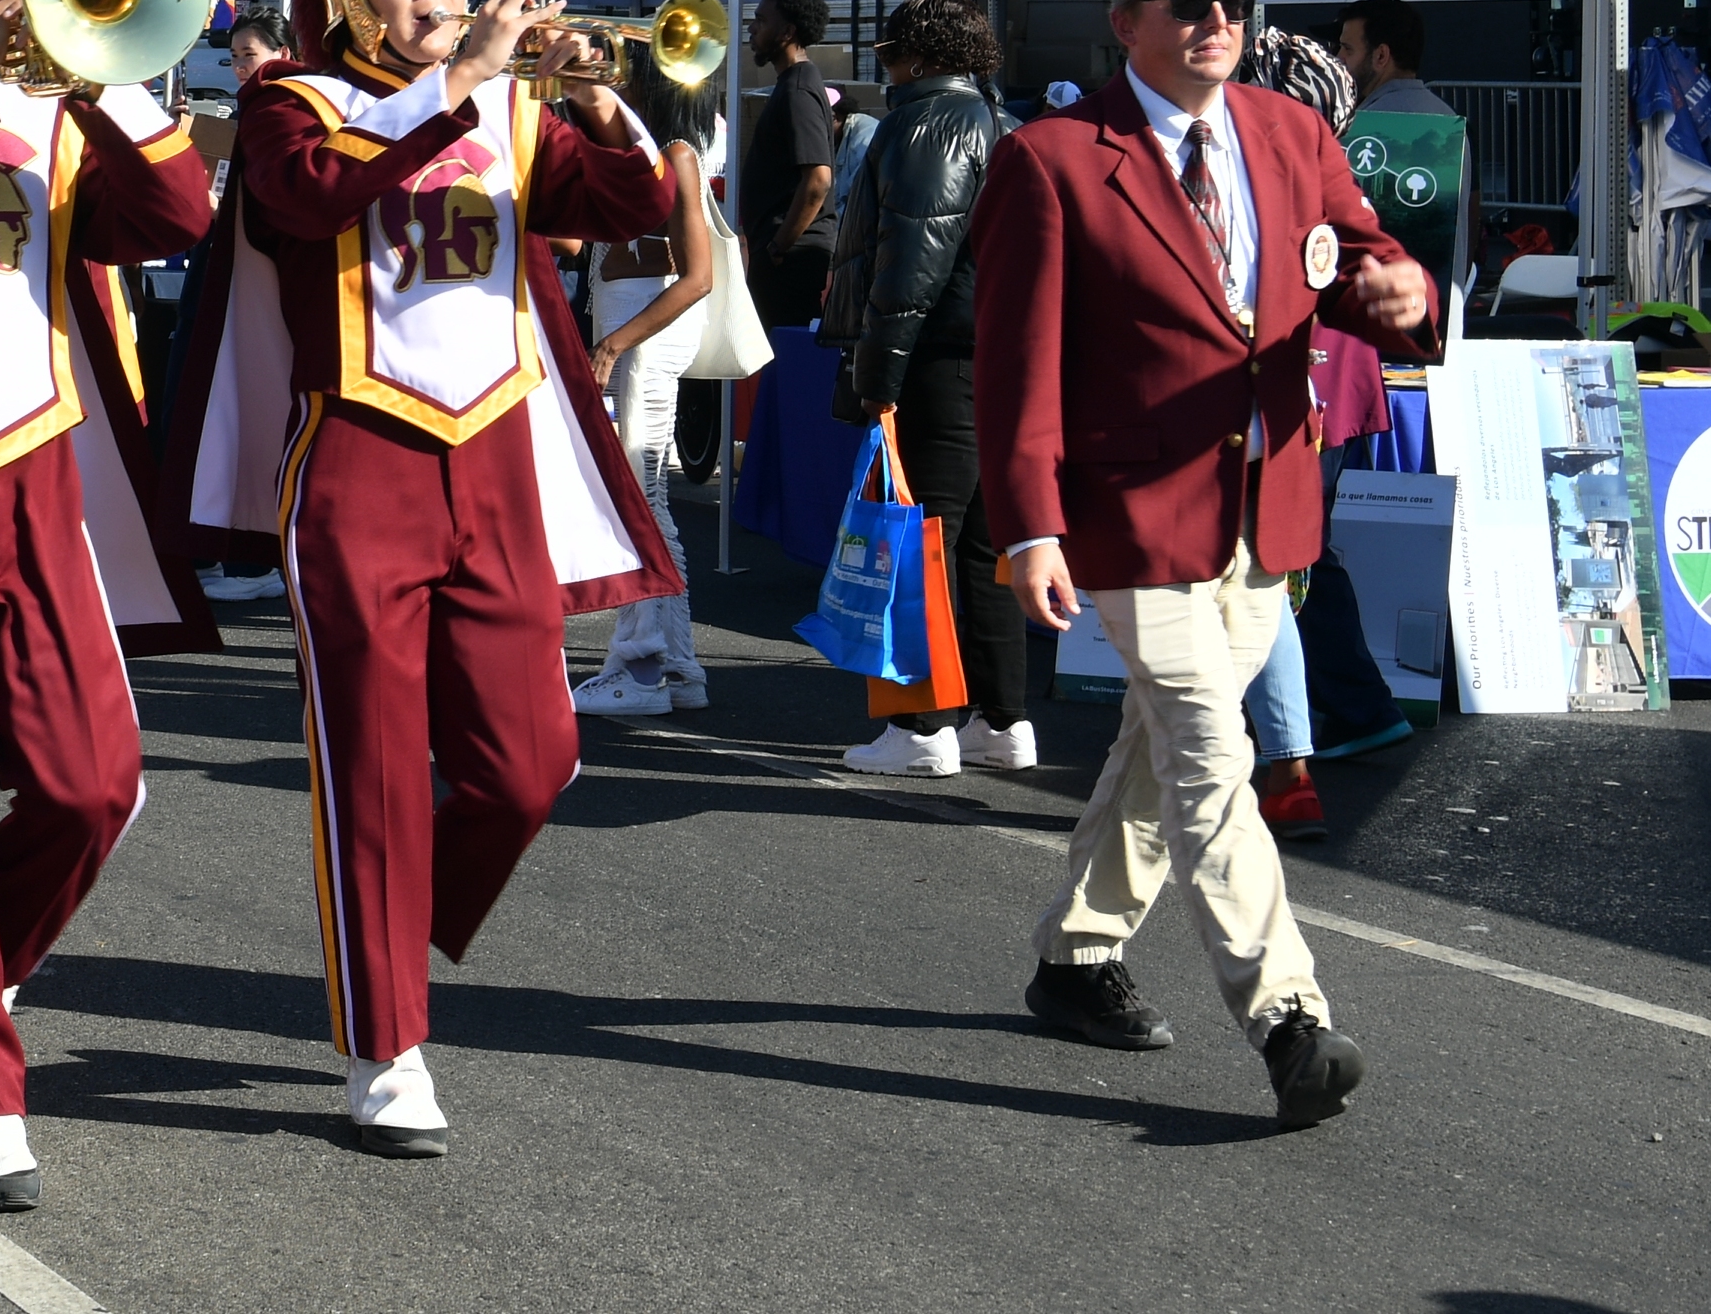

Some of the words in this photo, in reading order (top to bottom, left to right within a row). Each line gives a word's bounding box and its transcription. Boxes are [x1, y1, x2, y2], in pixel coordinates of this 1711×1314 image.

[1336, 491, 1346, 499] Lo
[1366, 492, 1407, 502] llamamos
[1460, 536, 1473, 588] Nuestras
[1465, 601, 1479, 661] Priorities
[1472, 665, 1482, 690] Our
